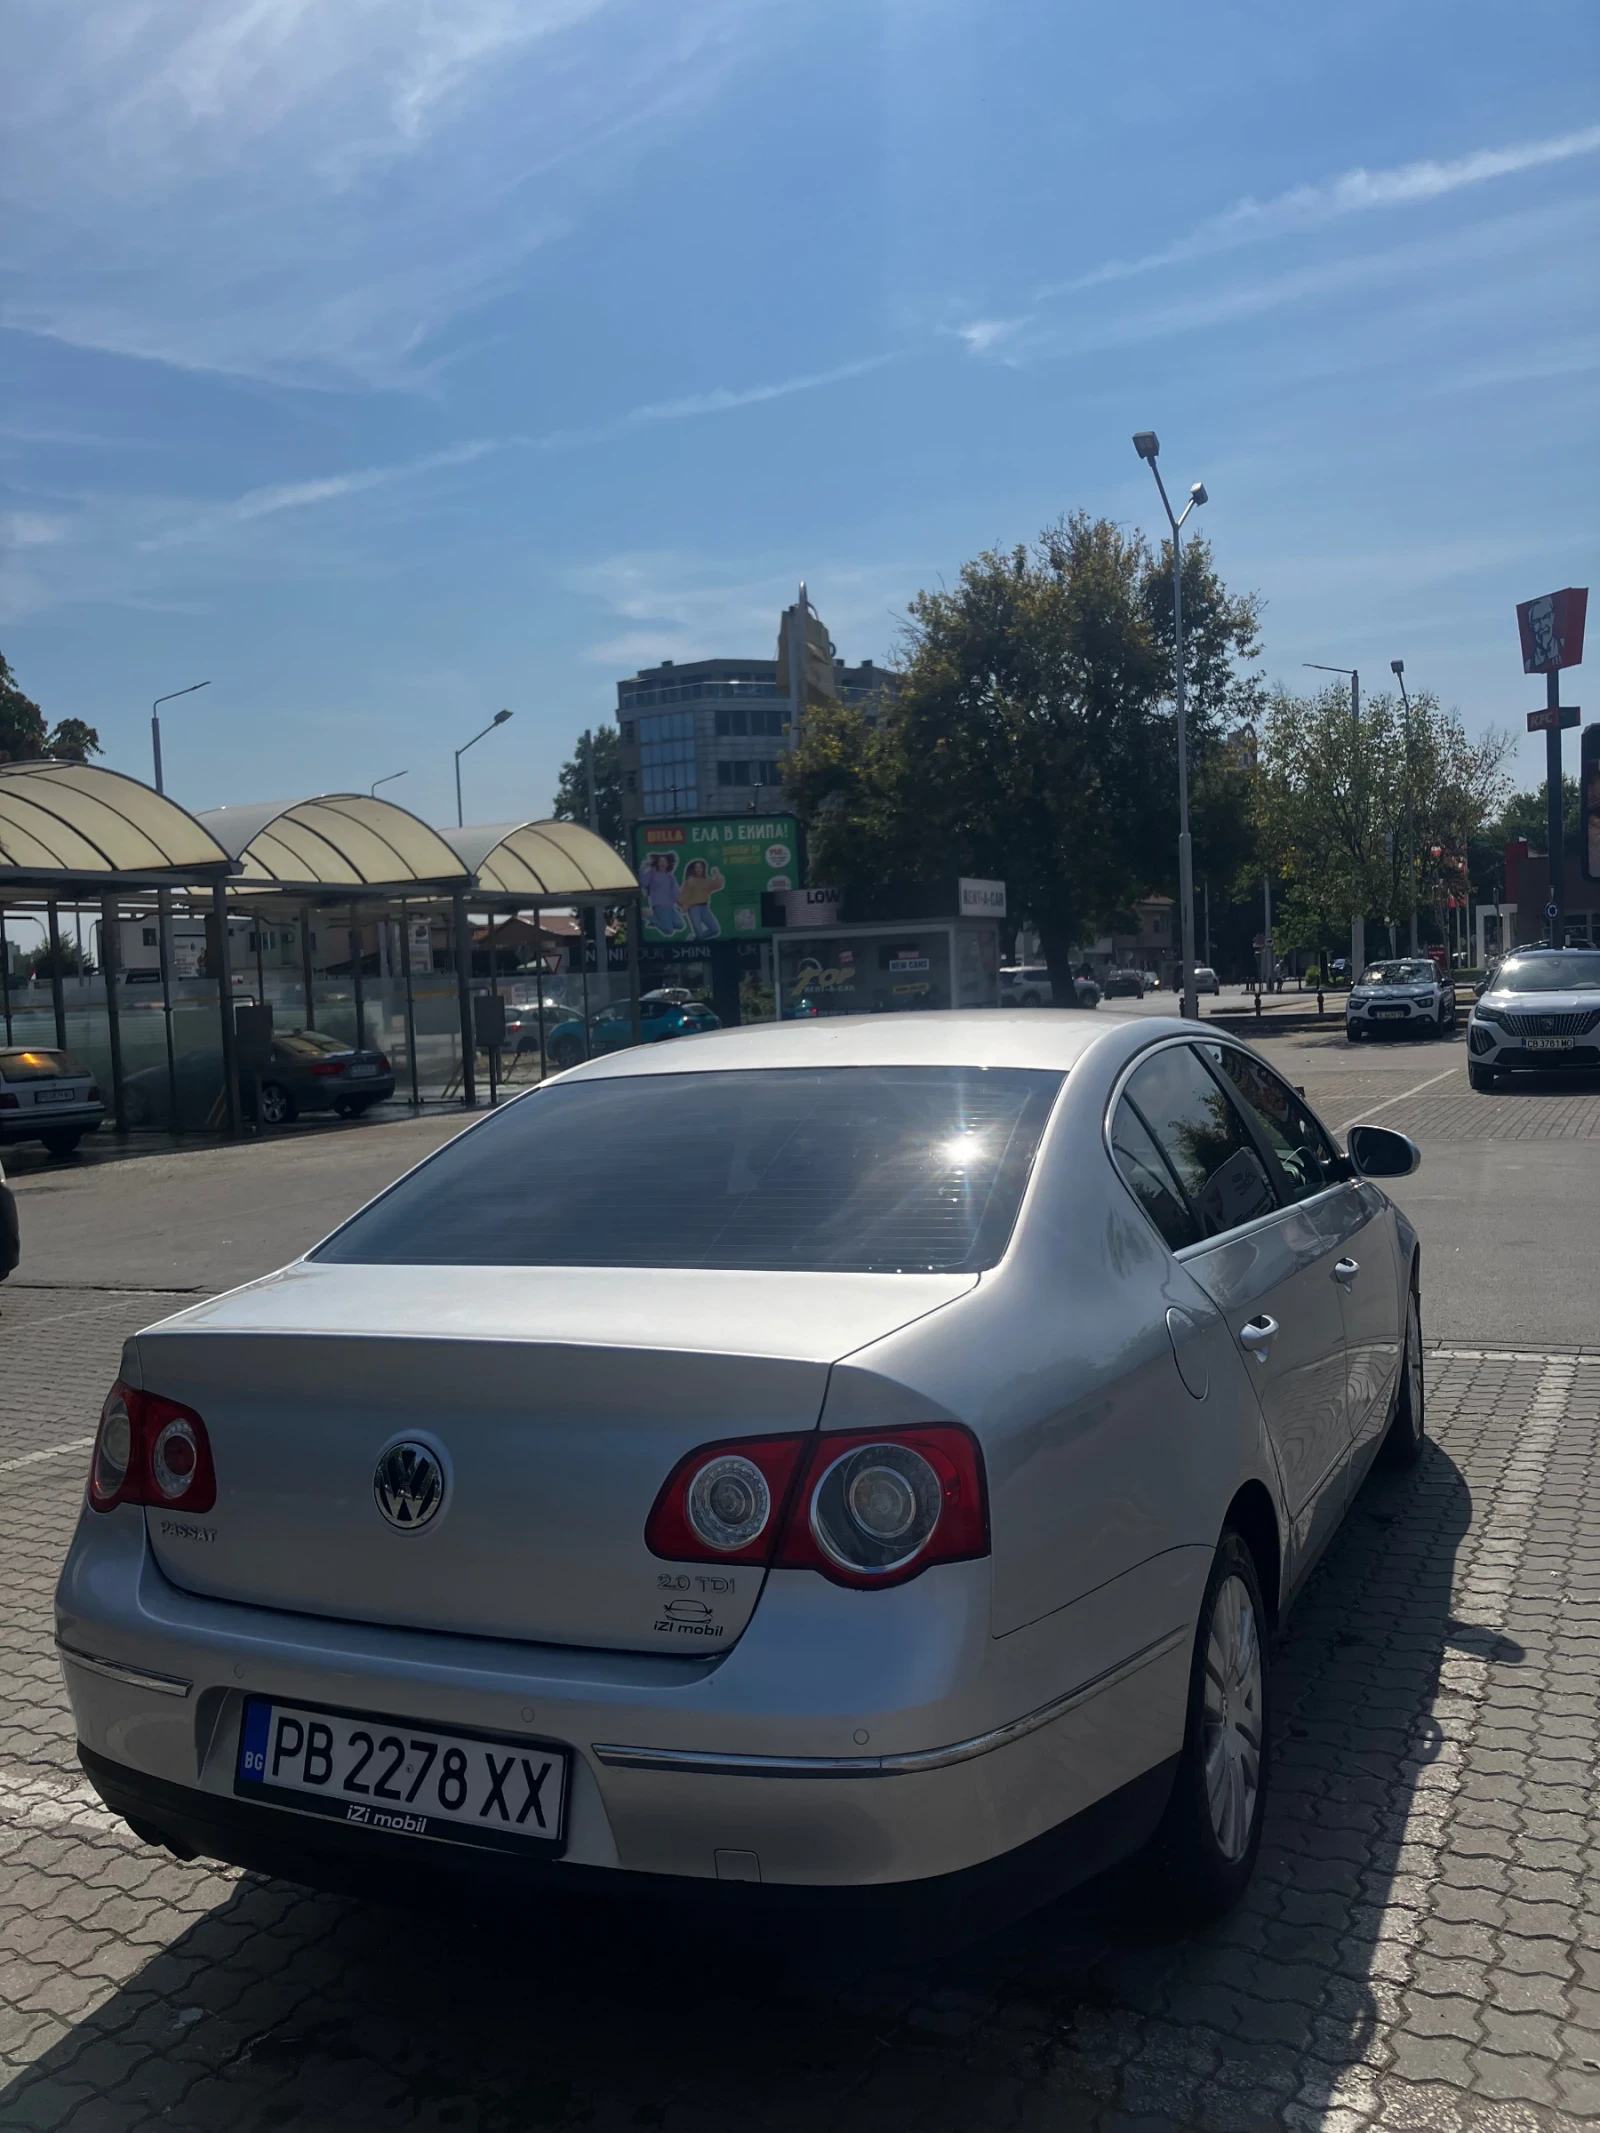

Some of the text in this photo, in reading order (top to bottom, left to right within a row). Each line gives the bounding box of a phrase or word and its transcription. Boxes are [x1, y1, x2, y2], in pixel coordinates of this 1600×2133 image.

[1530, 712, 1554, 727] KFC
[647, 829, 684, 843] BILLA
[691, 826, 720, 843] ЕЛА
[724, 825, 734, 842] В
[963, 889, 1004, 907] RENT-A-CAR
[908, 959, 928, 969] CARS
[790, 966, 856, 996] TOP
[803, 984, 856, 993] RENT-A-CAR
[1527, 1039, 1539, 1048] CB
[1539, 1039, 1560, 1048] 3781
[160, 1521, 217, 1543] PASSAT
[694, 1576, 735, 1594] TDI
[678, 1625, 724, 1637] mobil
[244, 1750, 264, 1771] BG
[271, 1716, 552, 1828] PB 2278 XX
[346, 1804, 428, 1833] iZi mobil
